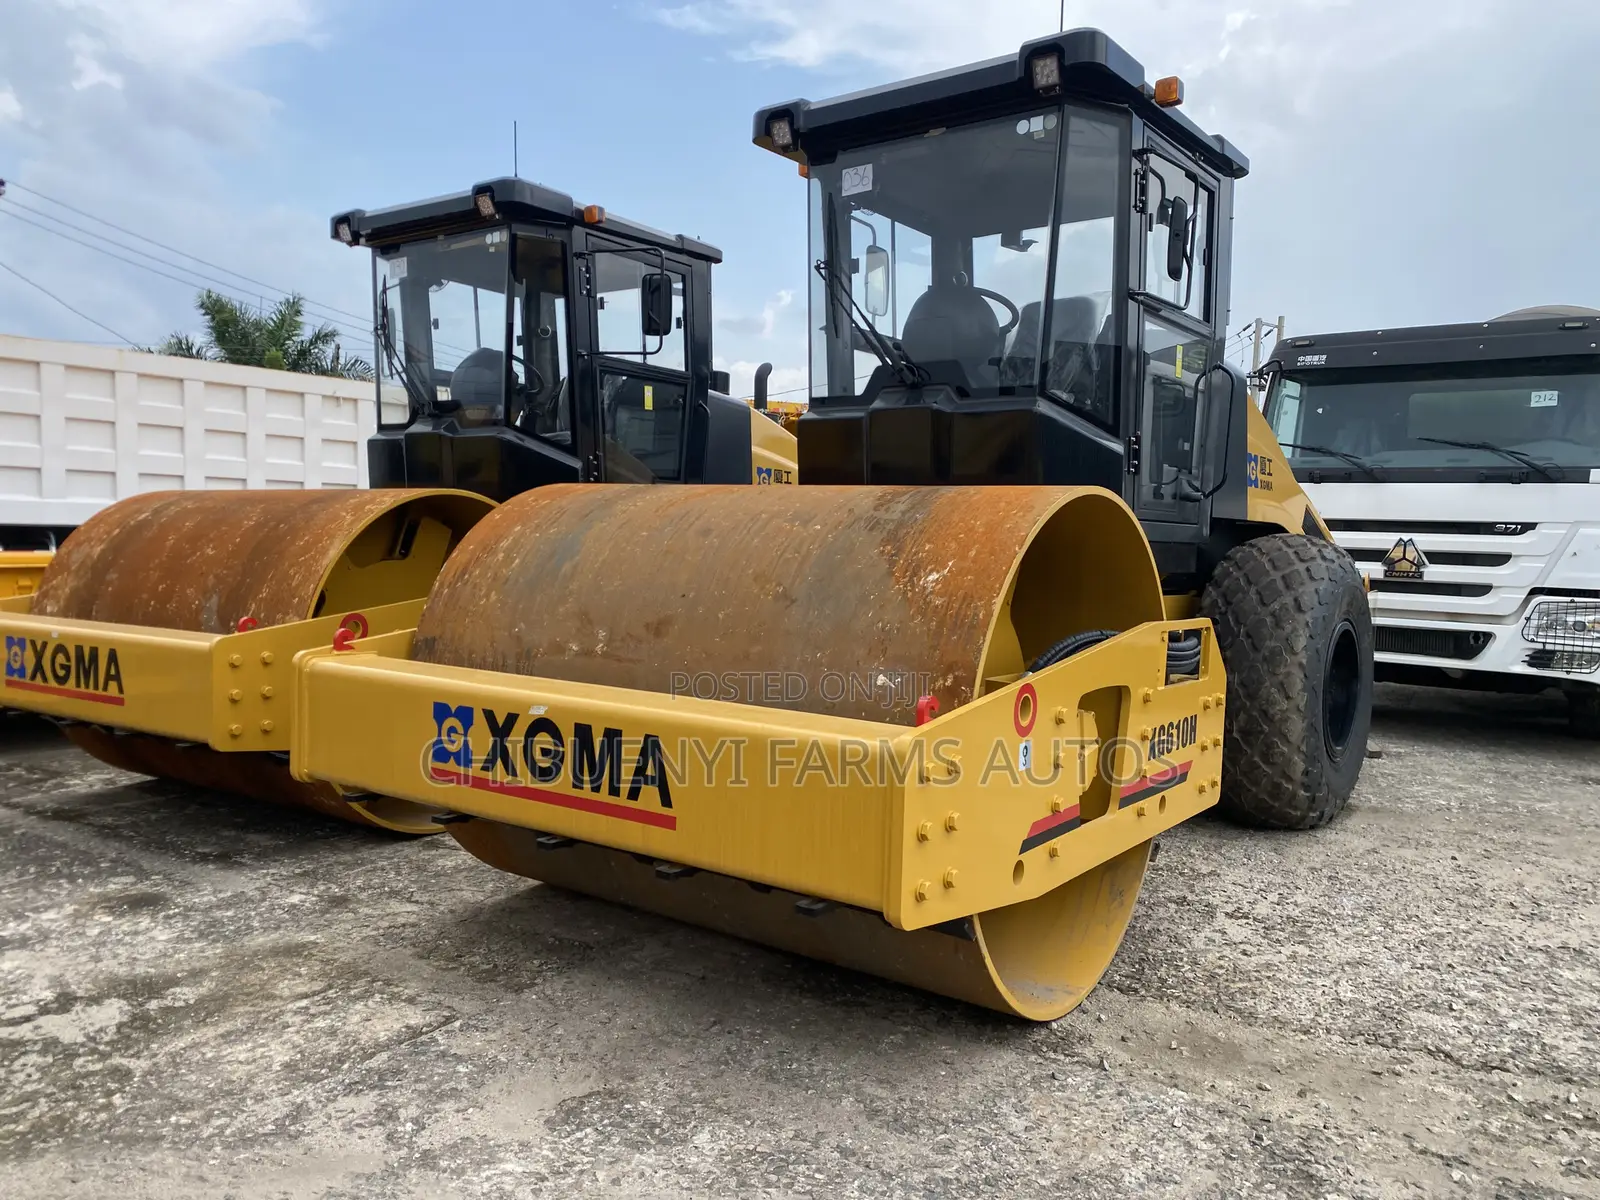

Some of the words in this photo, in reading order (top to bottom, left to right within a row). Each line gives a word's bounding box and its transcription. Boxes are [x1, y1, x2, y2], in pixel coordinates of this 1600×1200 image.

[1534, 393, 1557, 403] 212
[1494, 524, 1521, 532] 371
[29, 639, 124, 695] XGMA
[480, 708, 673, 808] XGMA
